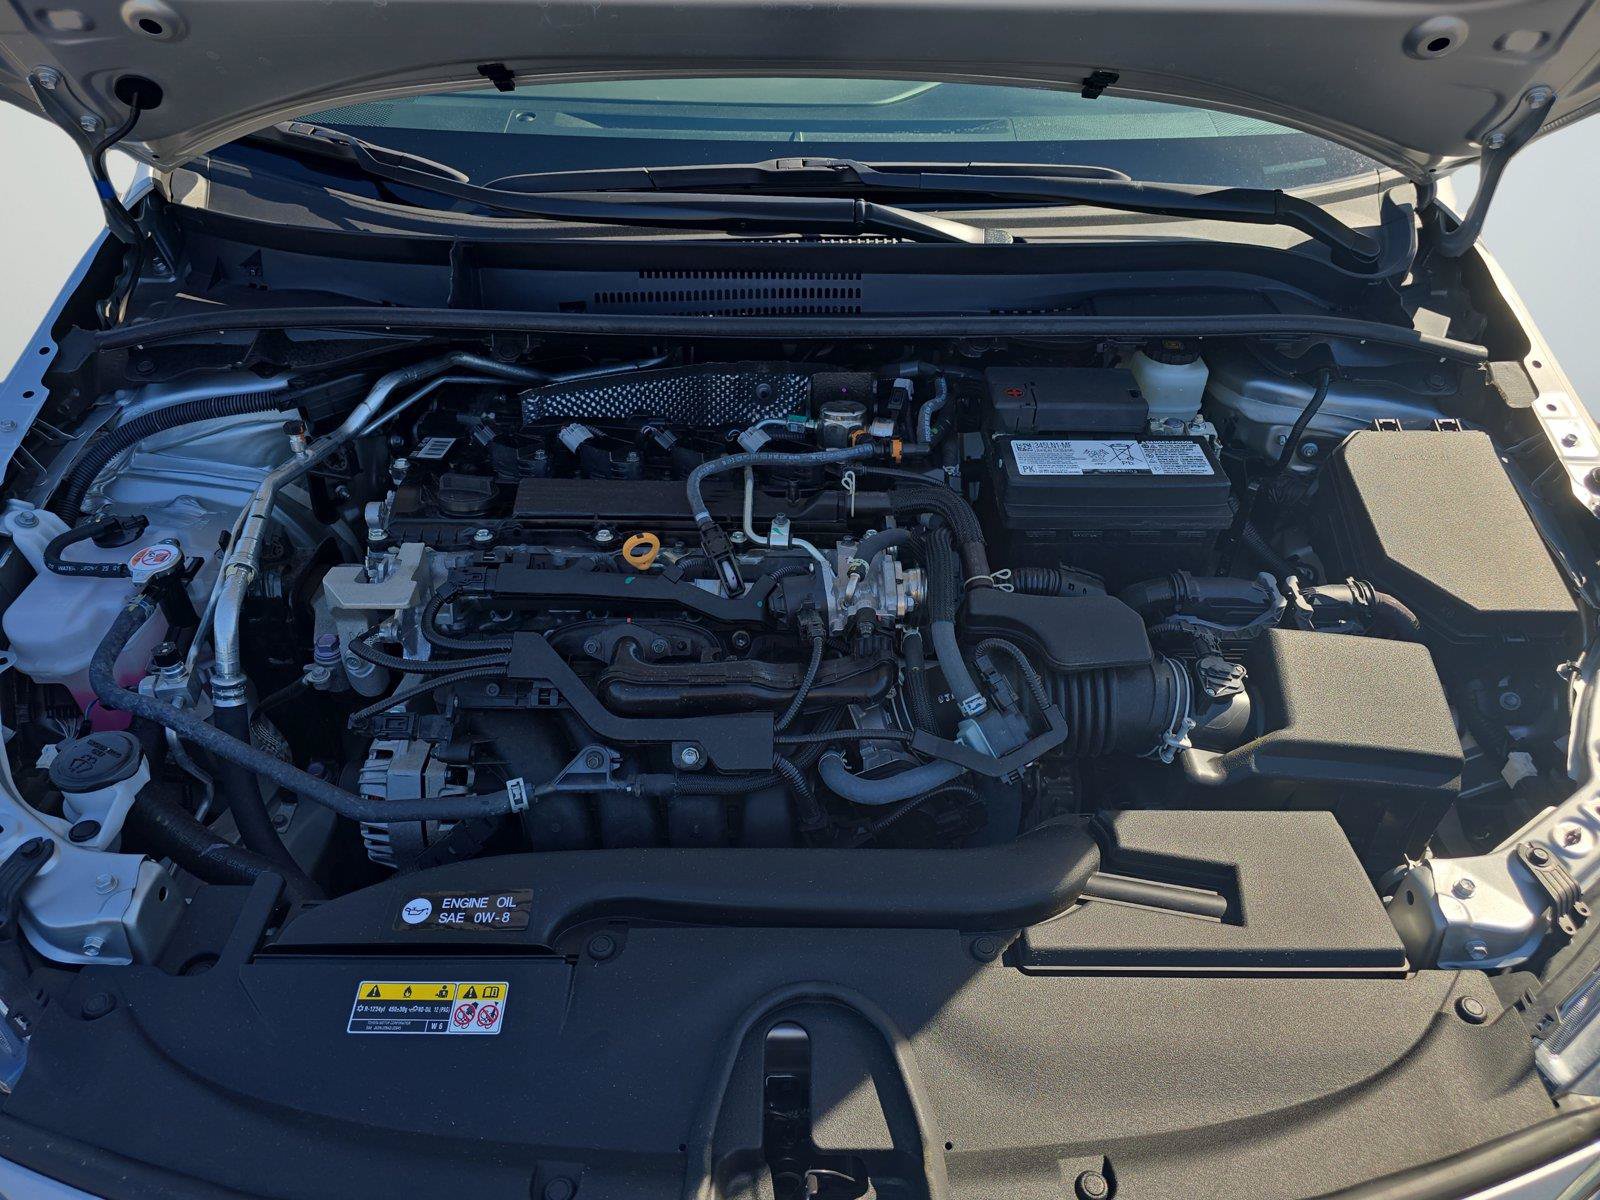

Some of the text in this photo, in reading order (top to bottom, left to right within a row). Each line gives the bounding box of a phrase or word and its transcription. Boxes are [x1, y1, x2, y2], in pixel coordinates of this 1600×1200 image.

[442, 896, 517, 909] ENGINE OIL
[438, 911, 511, 924] SAE 0W-8
[431, 1022, 437, 1030] W
